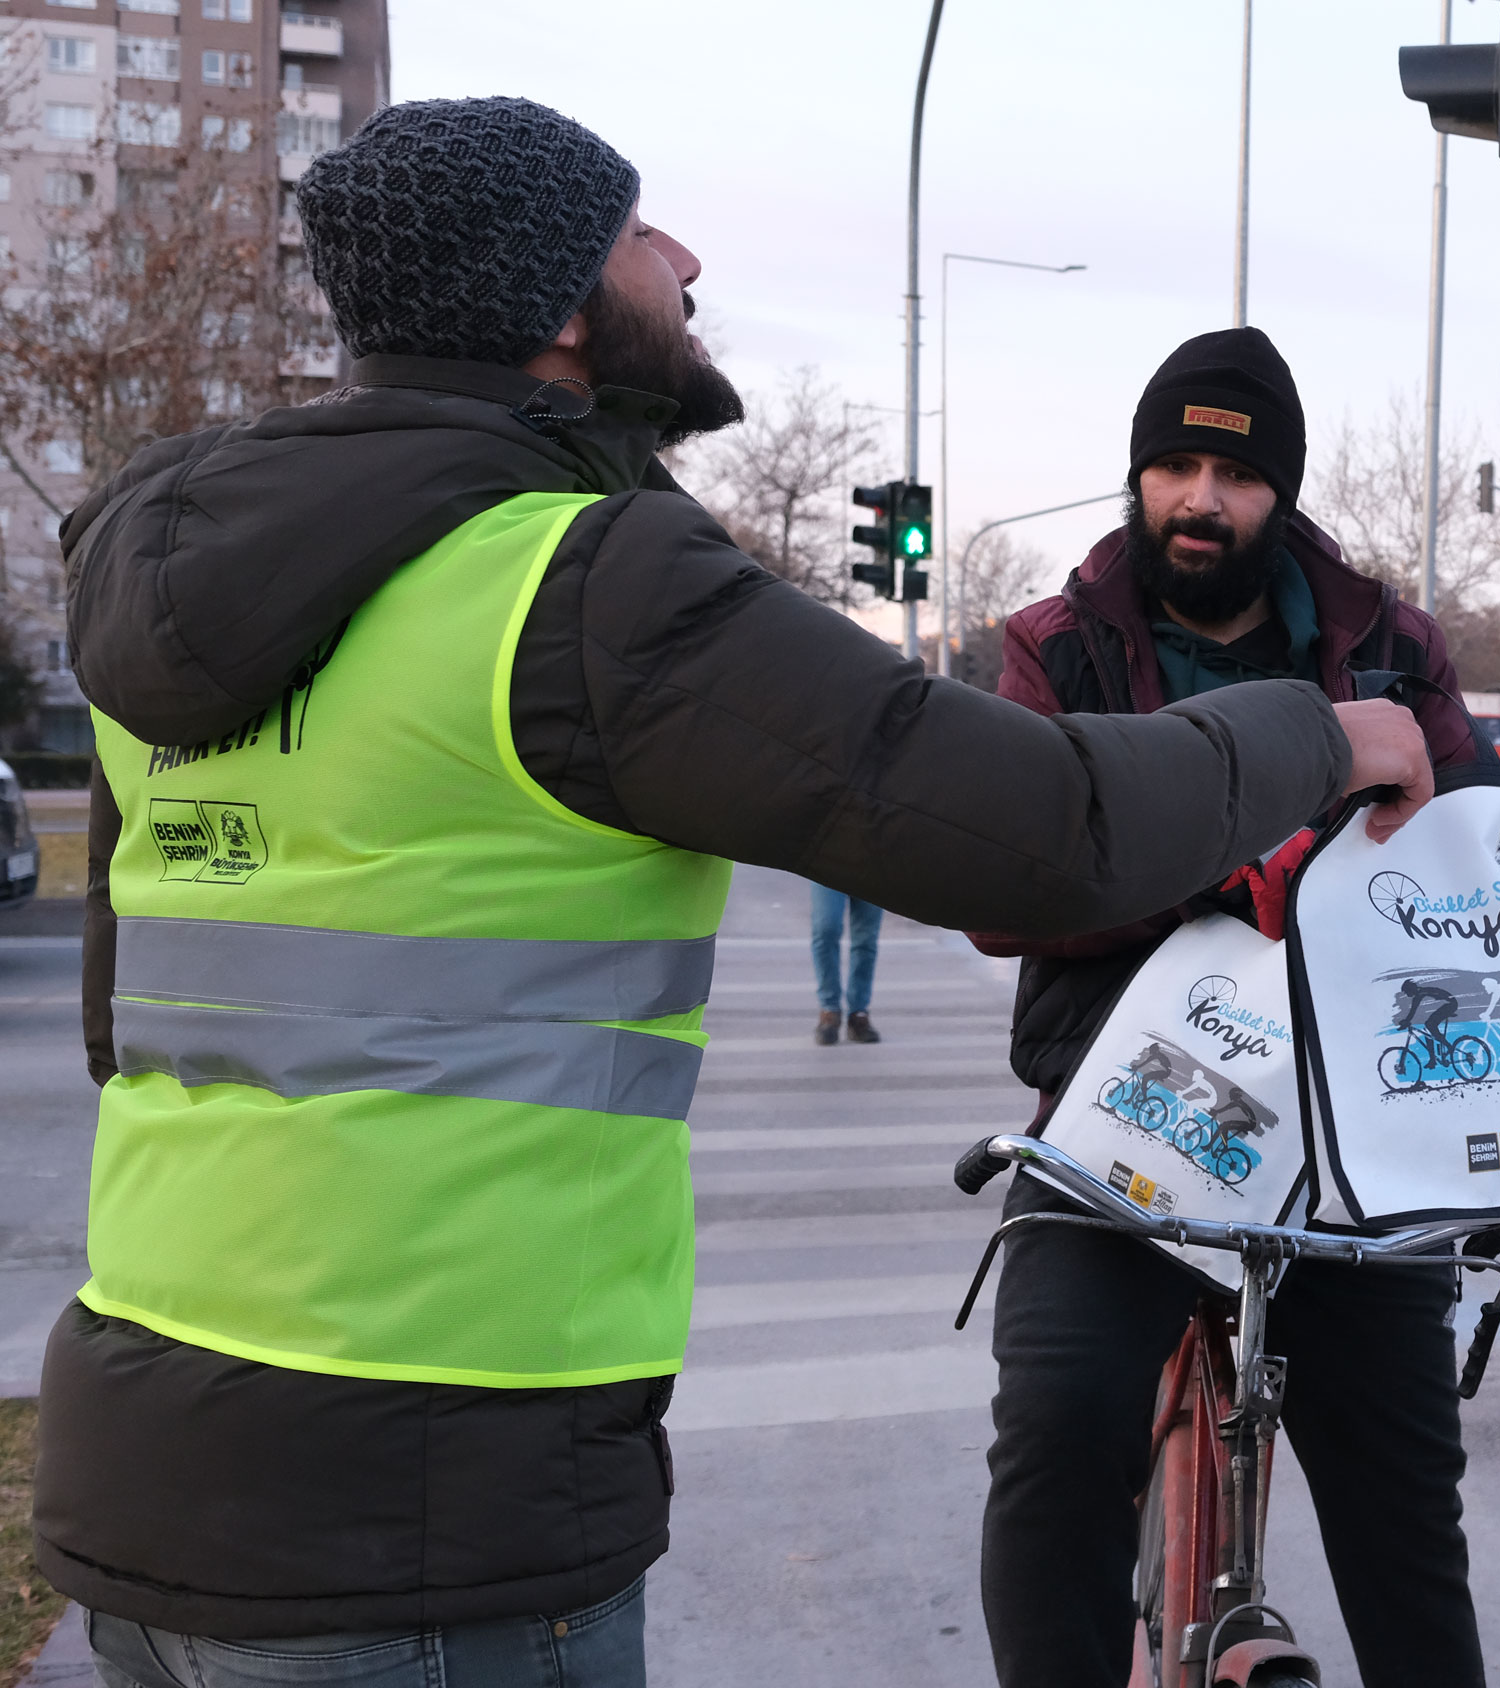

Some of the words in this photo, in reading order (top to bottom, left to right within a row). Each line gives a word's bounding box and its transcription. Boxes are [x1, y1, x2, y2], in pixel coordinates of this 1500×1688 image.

[1188, 409, 1246, 430] PIRELLI
[154, 822, 207, 841] BENİM
[162, 845, 209, 863] ŞEHRİM
[227, 849, 252, 861] KONYA
[1412, 886, 1490, 915] Bisiklet
[1217, 1001, 1265, 1031] Bisiklet
[1185, 996, 1274, 1062] Konya
[1468, 1141, 1498, 1154] BENİM
[1470, 1151, 1499, 1165] ŞEHRİM
